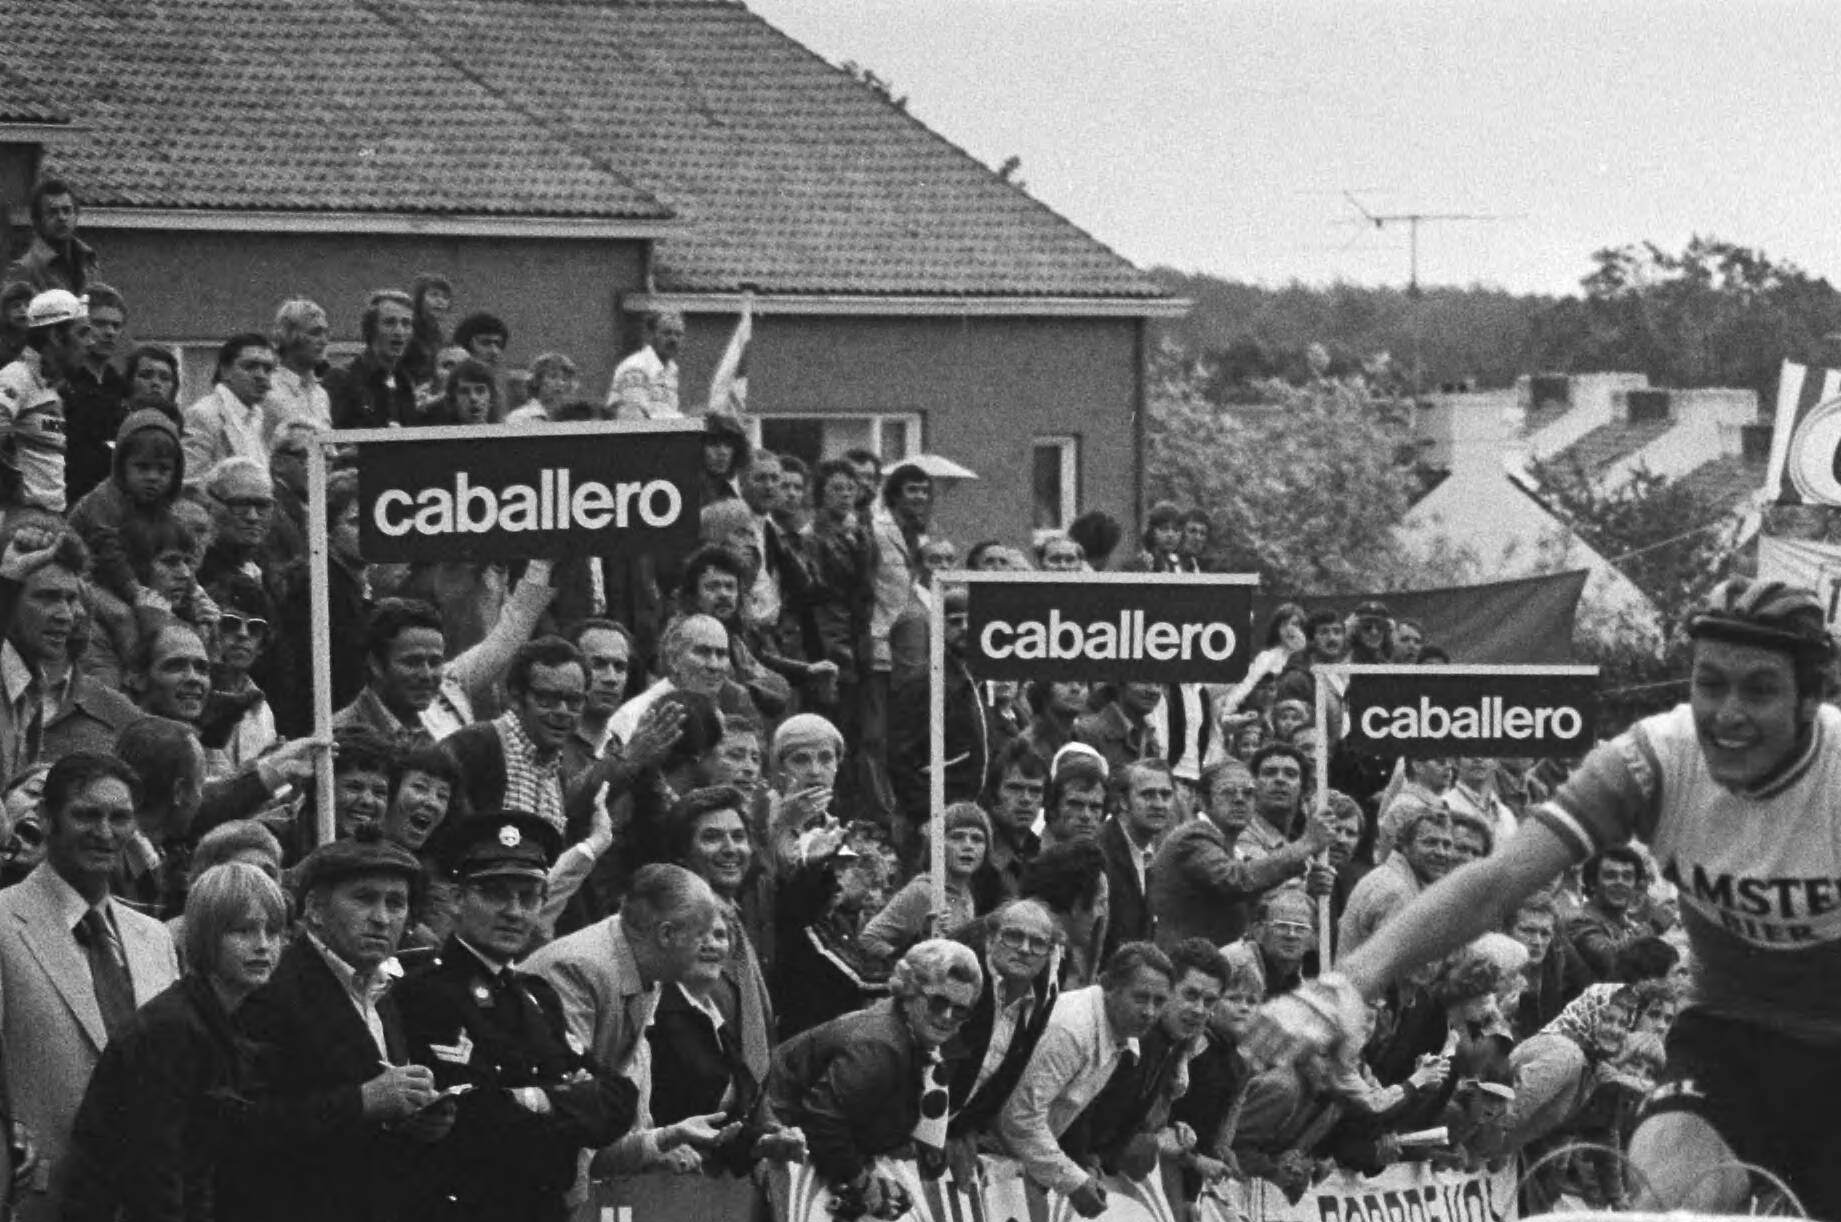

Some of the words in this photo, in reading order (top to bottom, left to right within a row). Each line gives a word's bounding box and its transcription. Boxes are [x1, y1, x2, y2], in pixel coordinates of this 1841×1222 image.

[373, 468, 682, 537] caballero
[979, 609, 1236, 661] caballero
[1361, 696, 1582, 740] caballero
